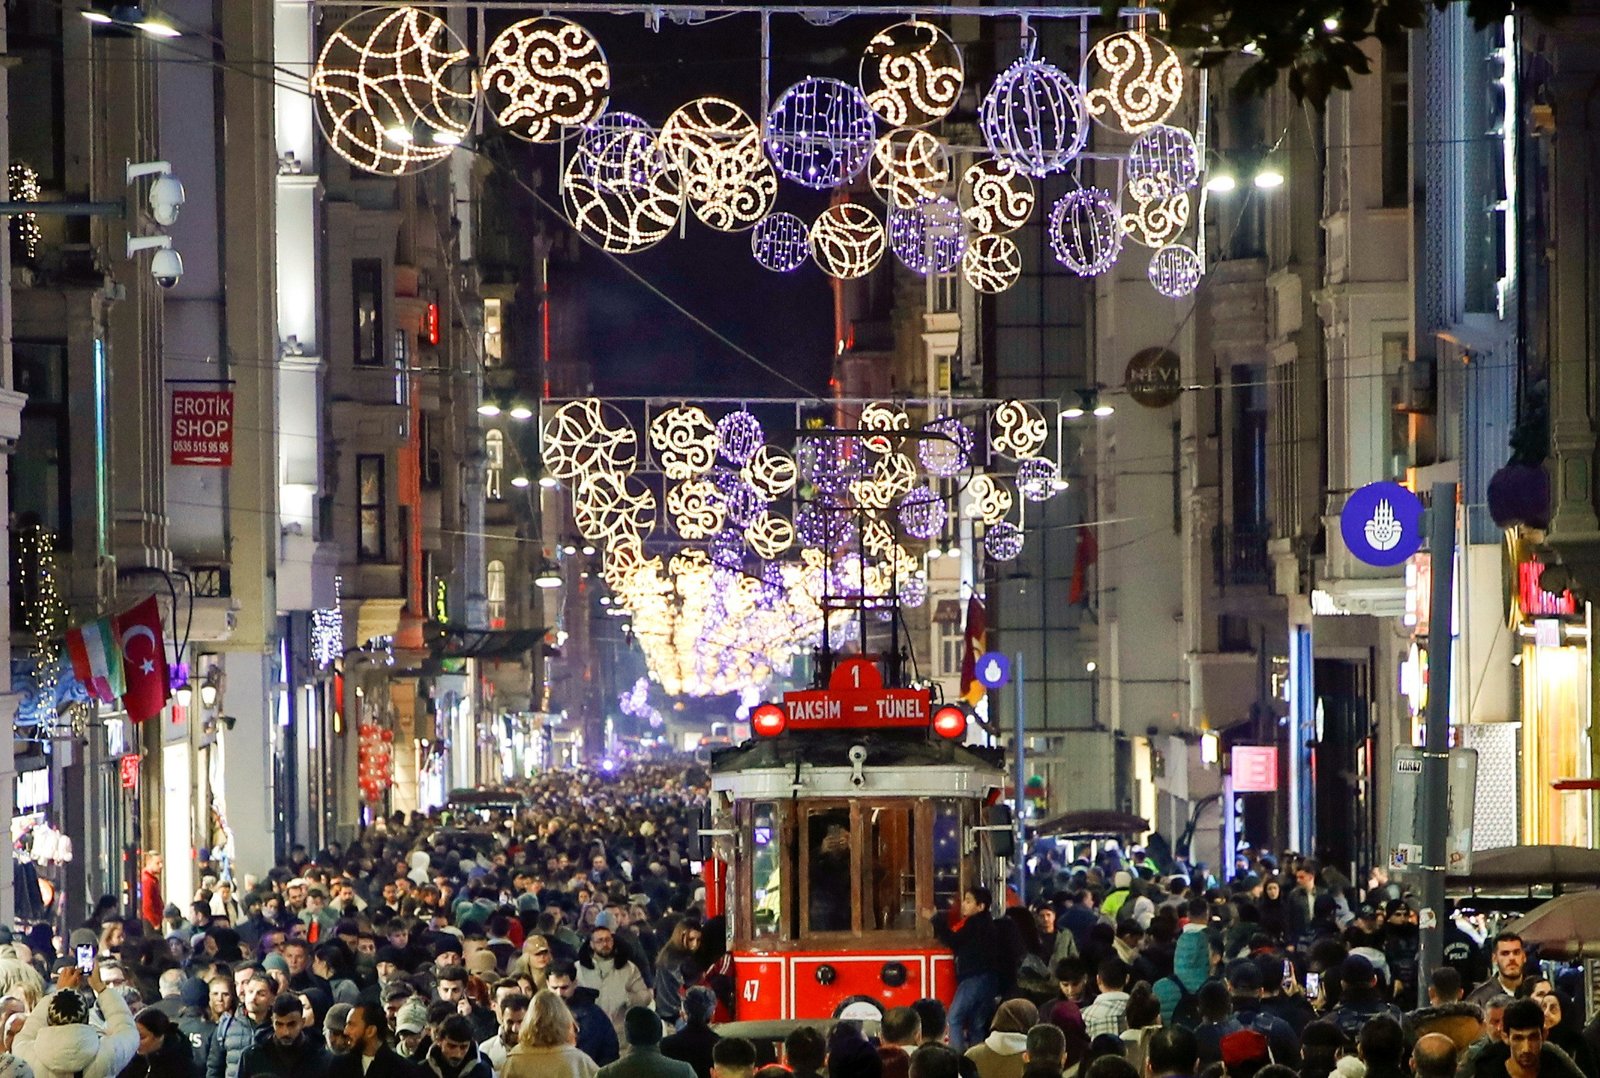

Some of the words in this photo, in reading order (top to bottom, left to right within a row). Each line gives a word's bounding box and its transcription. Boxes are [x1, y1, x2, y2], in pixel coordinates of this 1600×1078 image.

[174, 395, 230, 416] EROTİK
[176, 419, 228, 437] SHOP
[851, 664, 860, 688] 1
[787, 696, 841, 720] TAKSİM
[876, 695, 923, 718] TÜNEL
[744, 980, 759, 1002] 47
